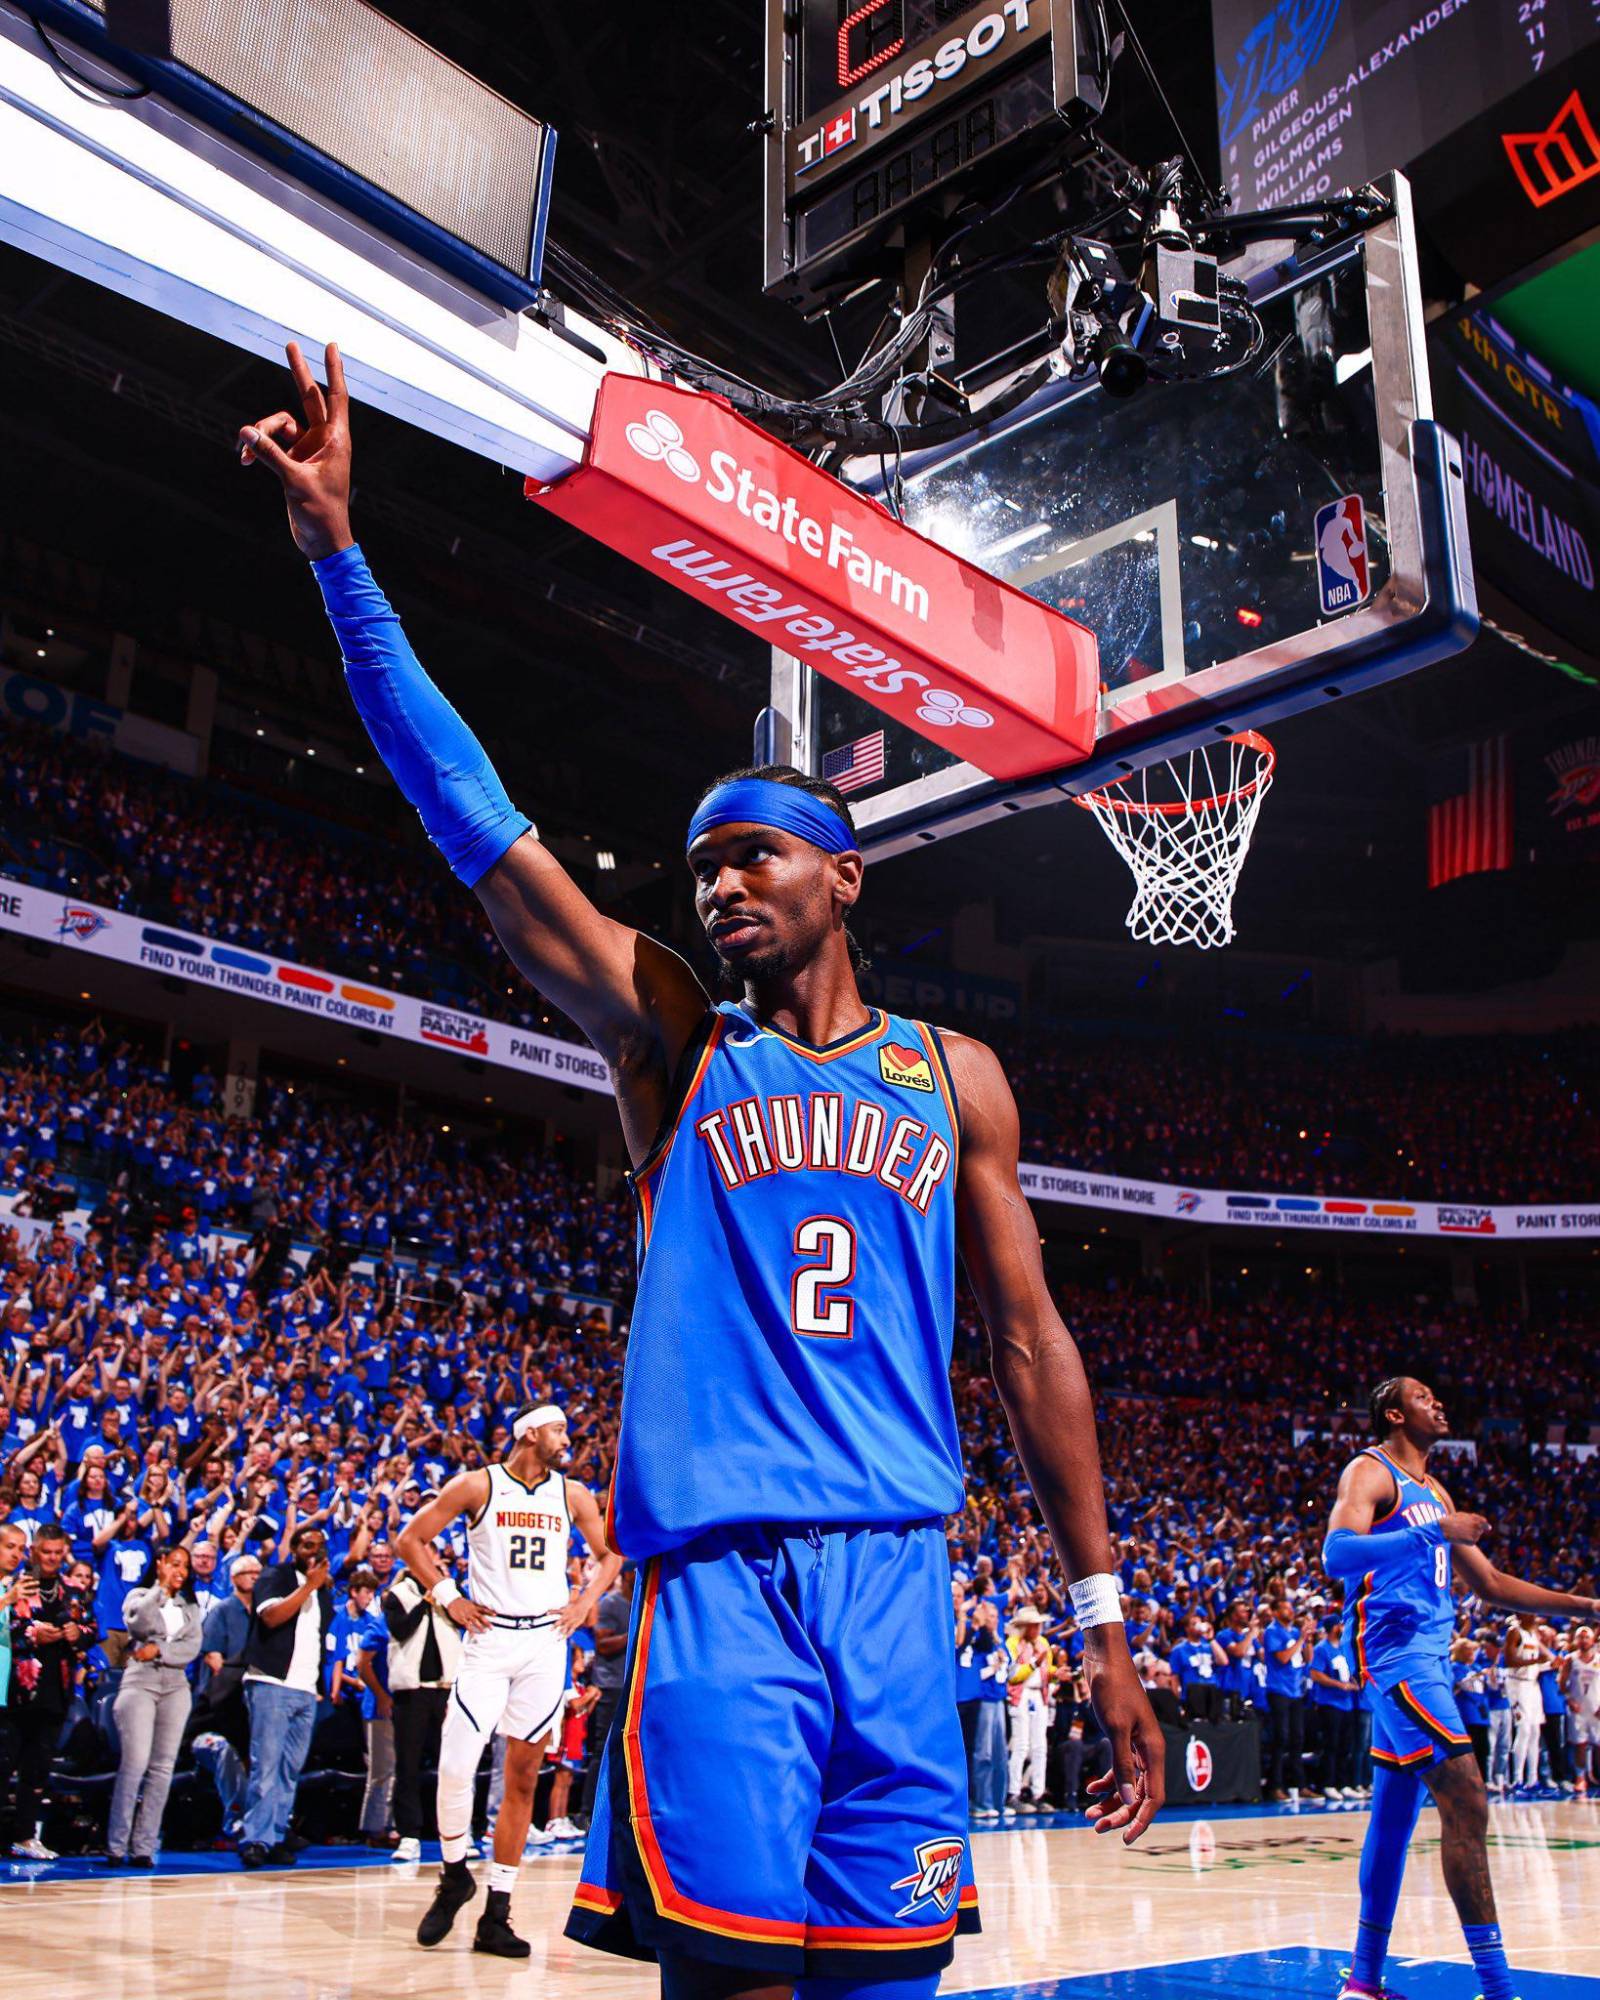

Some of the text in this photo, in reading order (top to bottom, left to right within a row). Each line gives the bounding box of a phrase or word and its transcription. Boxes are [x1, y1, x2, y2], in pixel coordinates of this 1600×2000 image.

[1525, 21, 1545, 45] 11
[859, 0, 1030, 128] TISSOT
[1531, 50, 1545, 72] 7
[1252, 88, 1299, 142] PLAYER
[1256, 102, 1352, 194] HOLMGREN
[1257, 137, 1343, 212] WILLIAMS
[1458, 317, 1564, 432] 4th QTR
[1463, 431, 1595, 591] HOMELAND
[1328, 583, 1351, 606] NBA
[140, 946, 395, 1029] FIND YOUR THUNDER PAINT COLORS AT
[420, 1016, 473, 1042] PAINT
[421, 1005, 486, 1031] SPECTRUM
[510, 1039, 607, 1081] PAINT STORES
[696, 1092, 950, 1217] THUNDER
[1019, 1172, 1039, 1189] INT
[1041, 1175, 1087, 1195] STORES
[1090, 1182, 1120, 1199] WITH
[1122, 1187, 1156, 1206] MORE
[1227, 1209, 1417, 1230] FIND YOUR THUNDER PAINT COLORS AT
[1438, 1214, 1482, 1227] PAINT
[1516, 1213, 1556, 1229] PAINT
[792, 1215, 857, 1339] 2
[496, 1511, 562, 1533] NUGGETS
[510, 1535, 546, 1571] 22
[1434, 1544, 1448, 1590] 8
